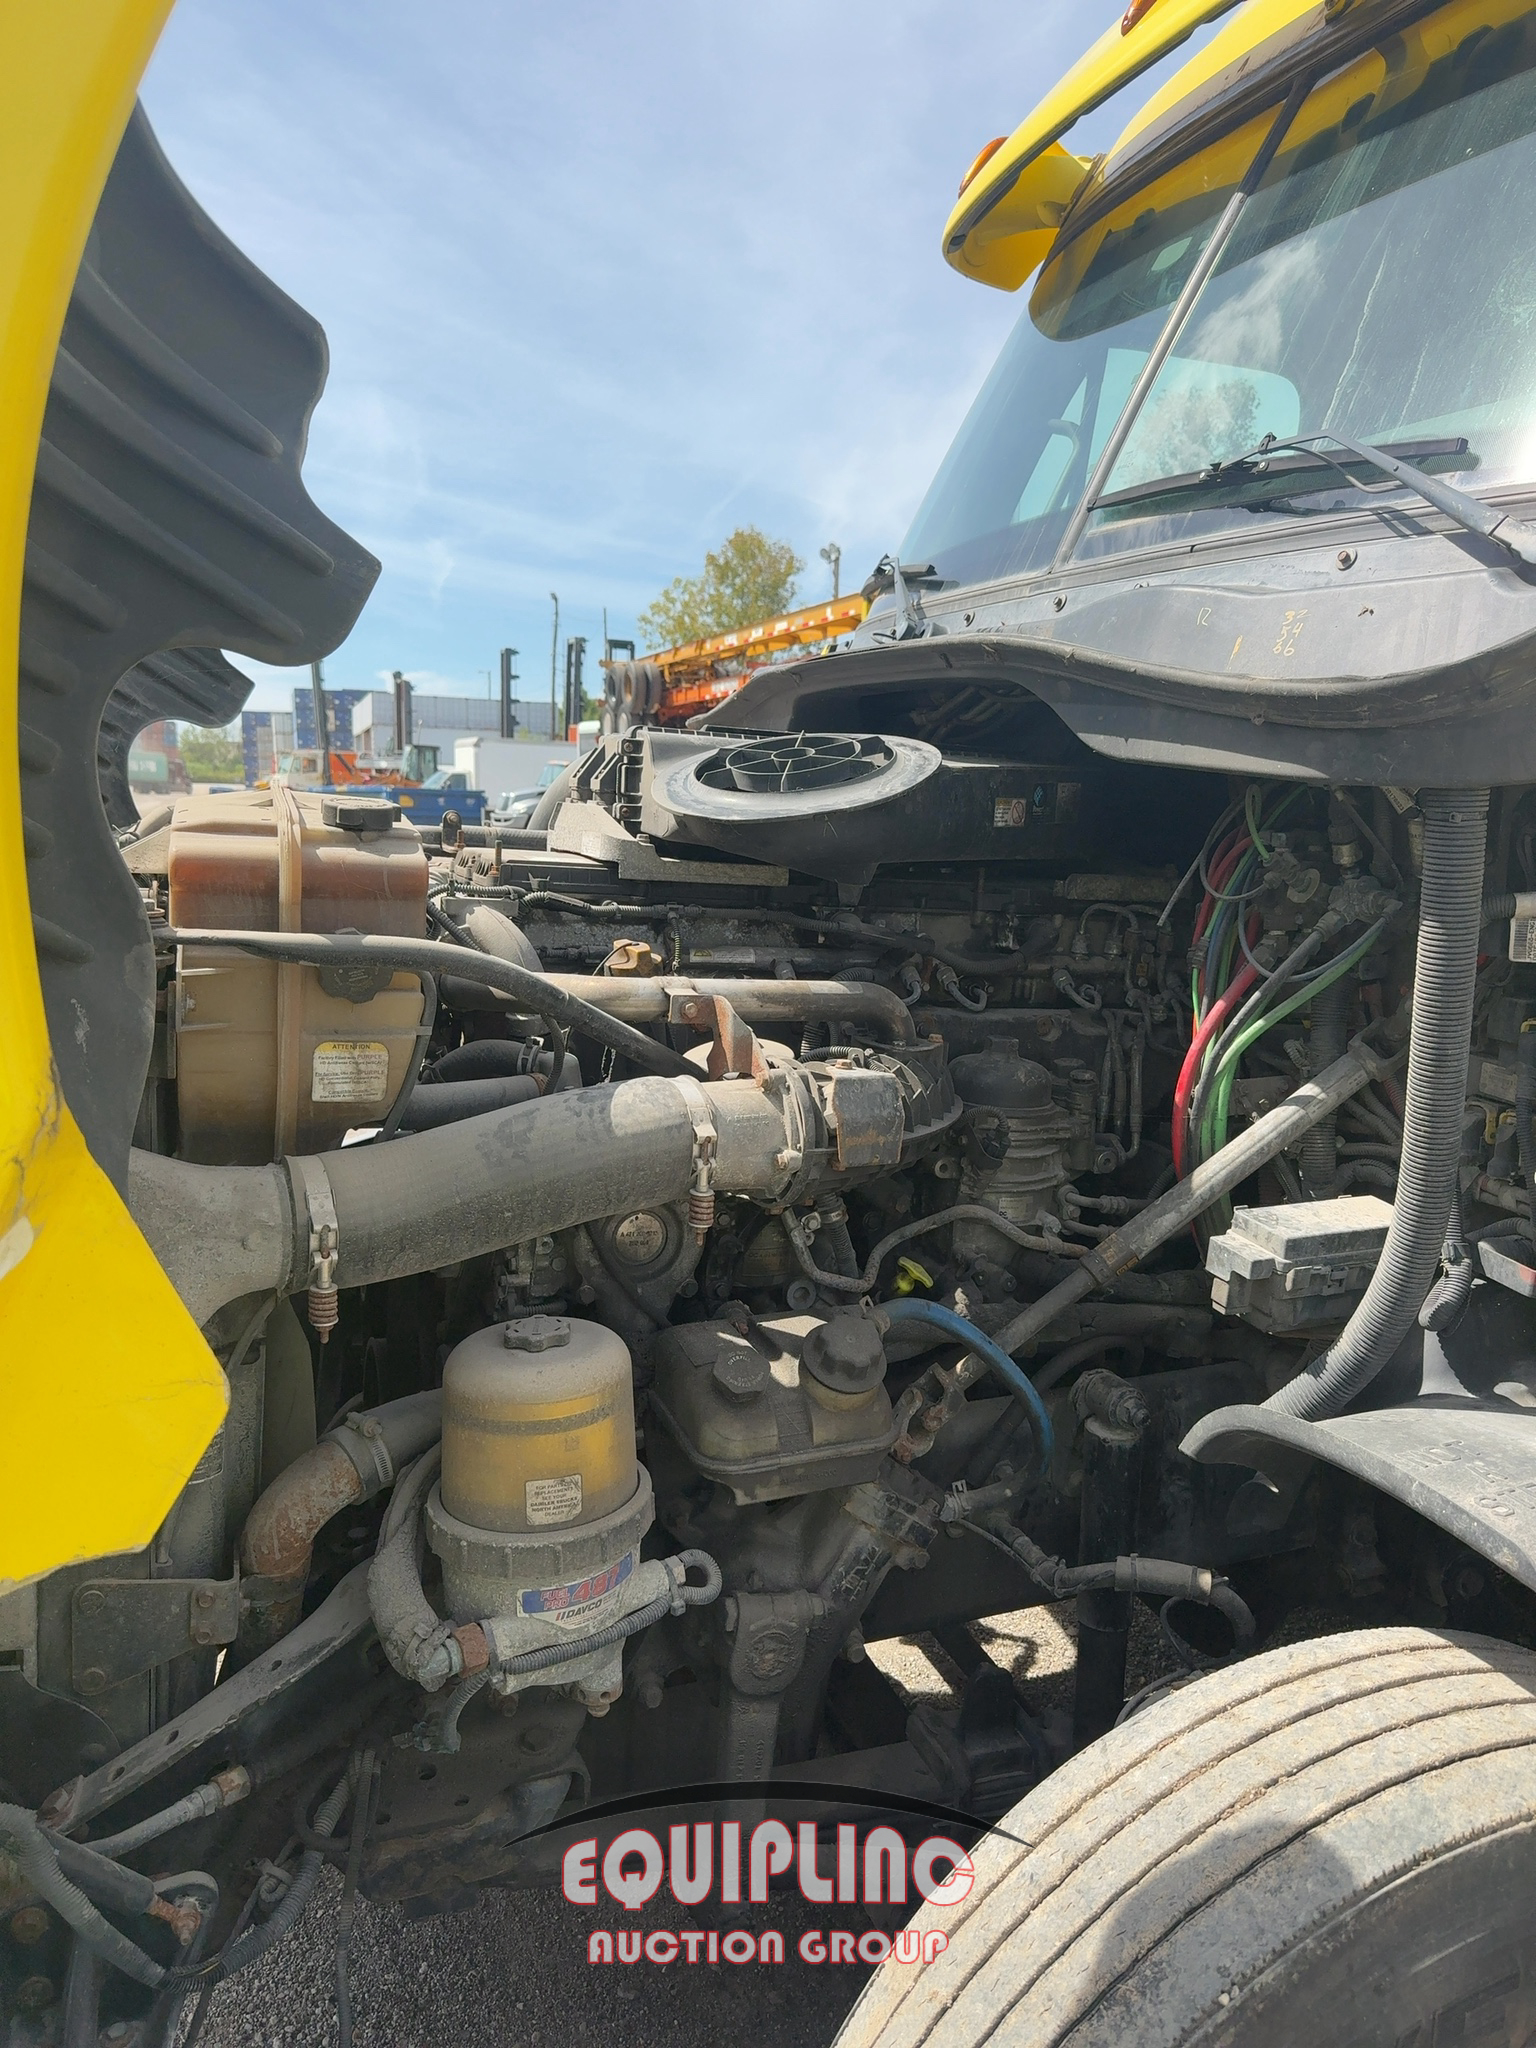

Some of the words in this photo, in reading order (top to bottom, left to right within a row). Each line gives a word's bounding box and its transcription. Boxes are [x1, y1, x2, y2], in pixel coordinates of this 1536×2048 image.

[541, 1587, 570, 1602] FUEL
[544, 1598, 570, 1611] PRO
[566, 1598, 603, 1618] DAVCO
